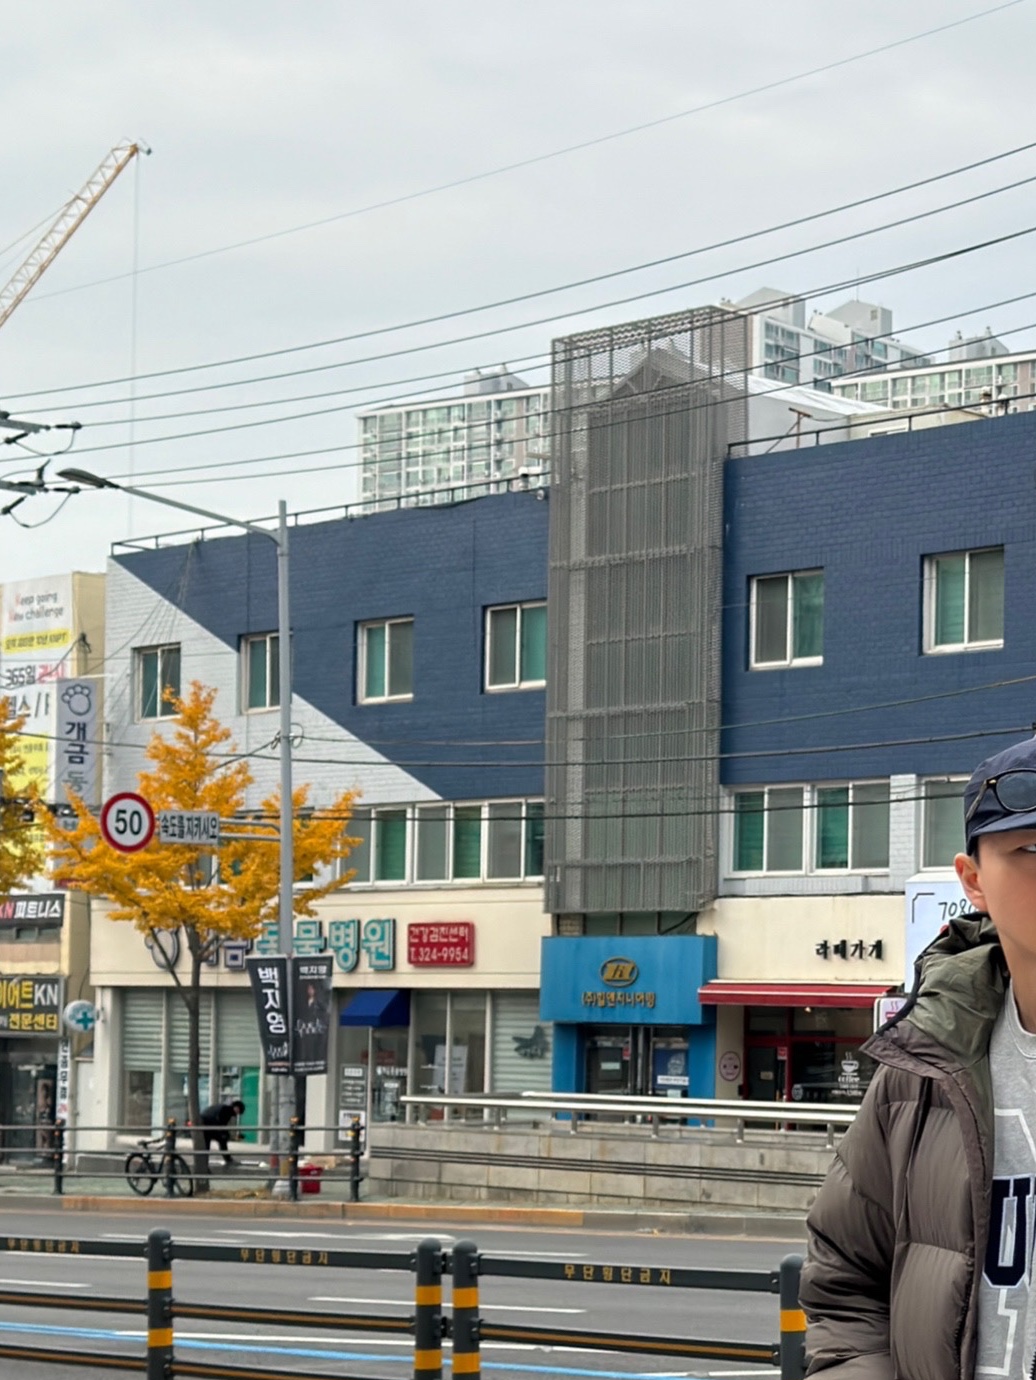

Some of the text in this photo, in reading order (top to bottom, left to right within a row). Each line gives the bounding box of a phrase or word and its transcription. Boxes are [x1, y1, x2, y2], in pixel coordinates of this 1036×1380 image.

[114, 809, 142, 836] 50
[409, 926, 469, 943] 건강검진센터
[410, 946, 469, 962] T.324-9954
[258, 966, 286, 1034] 백지영
[563, 1264, 673, 1285] 무단횡단금지
